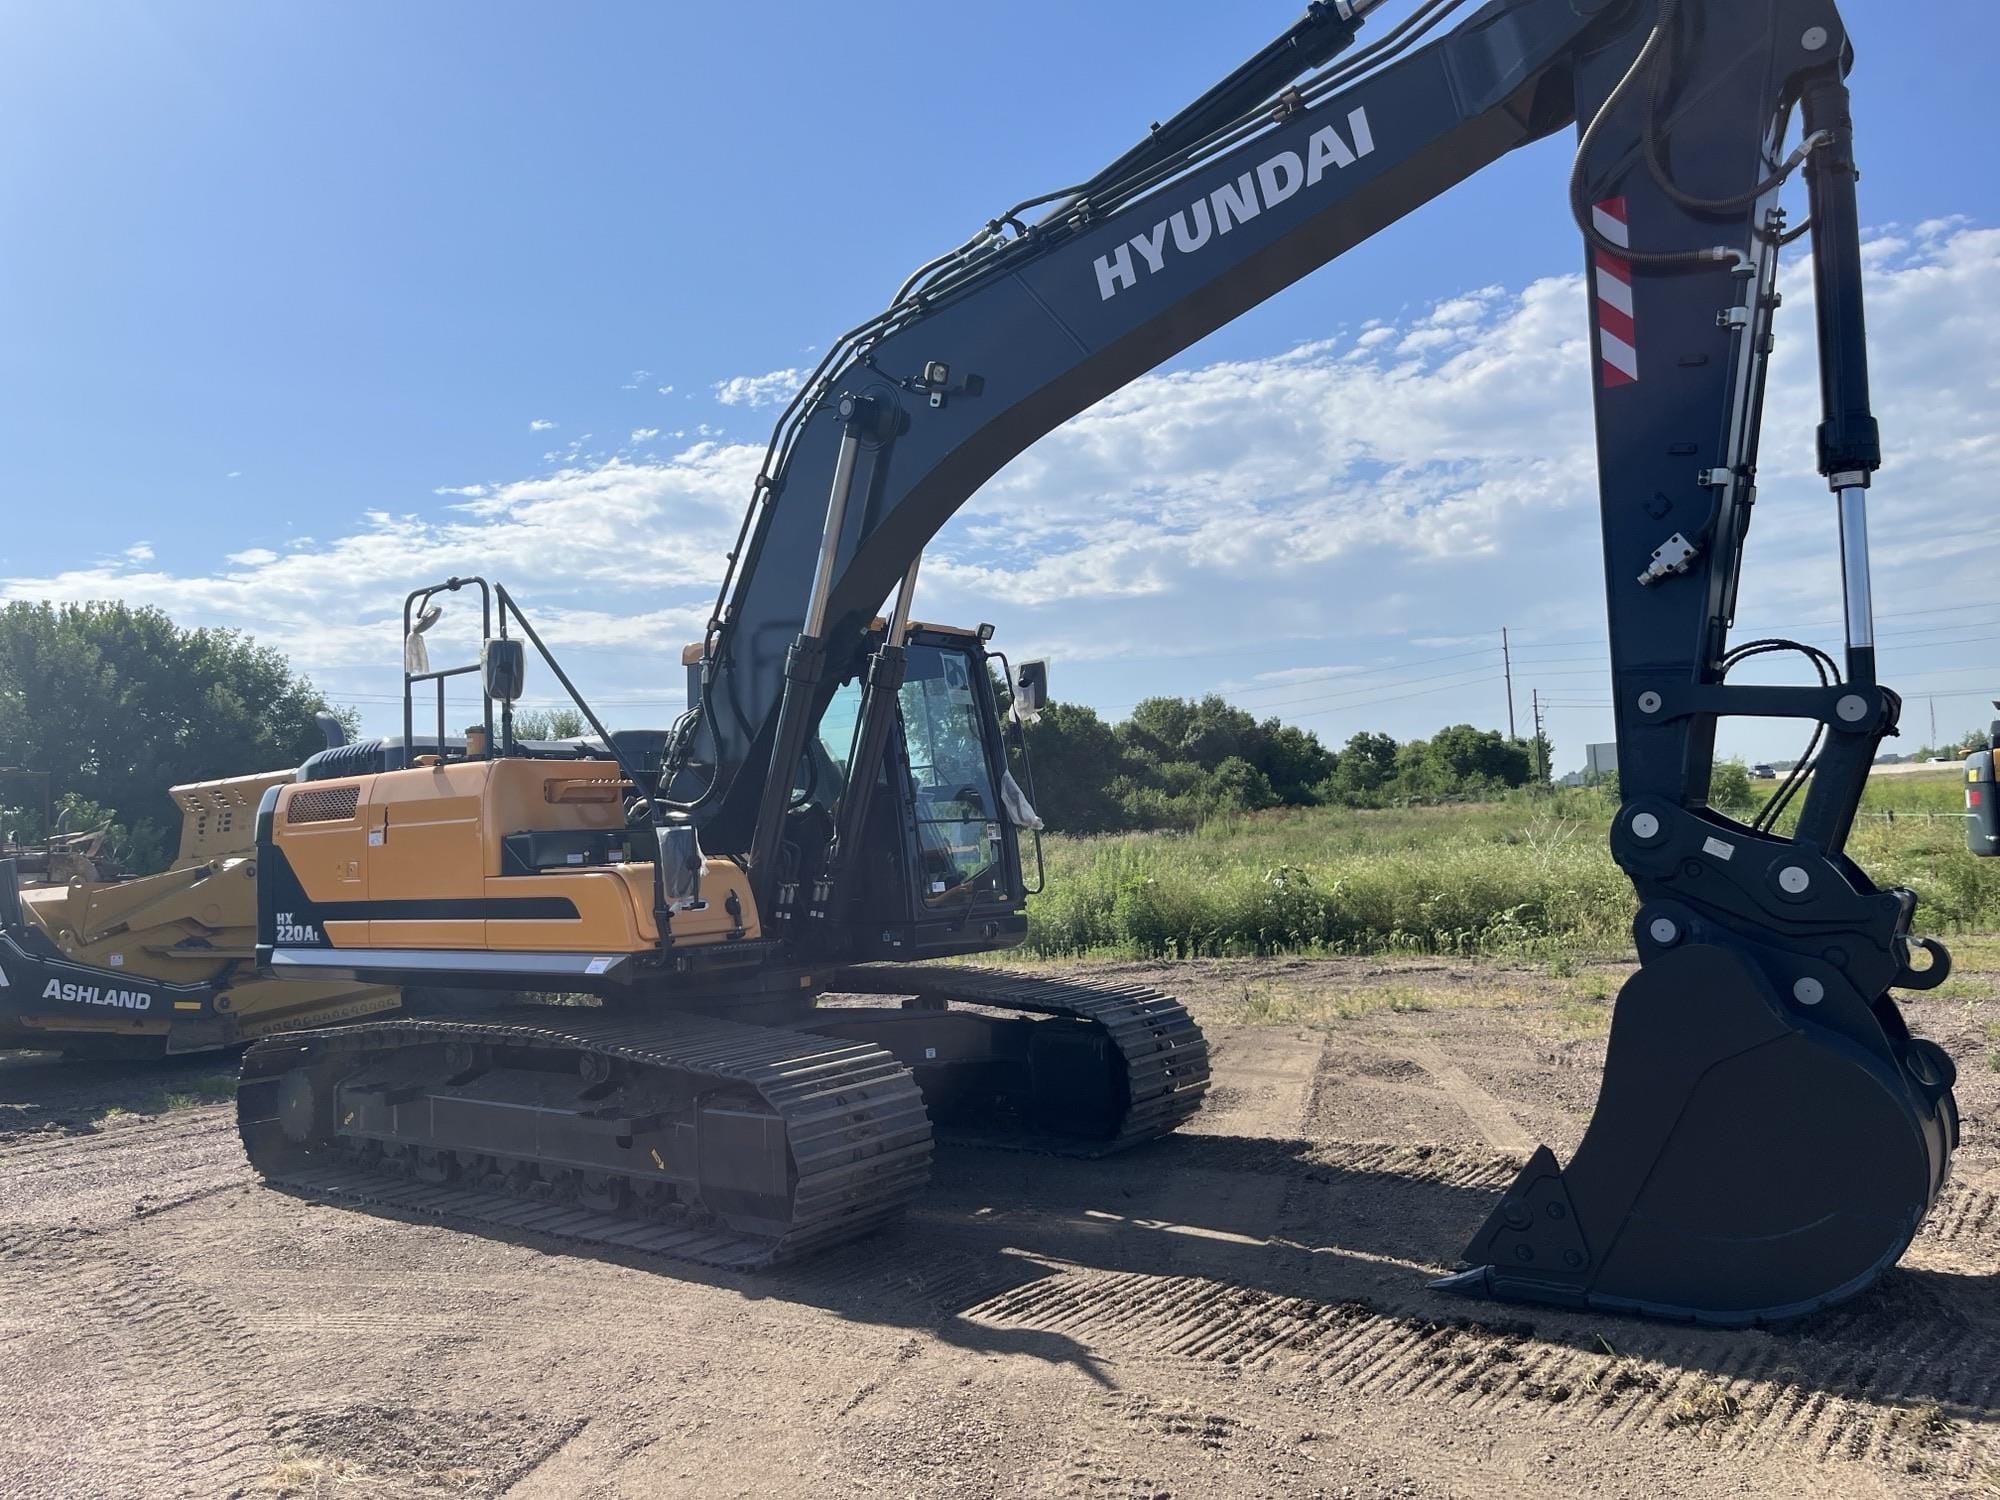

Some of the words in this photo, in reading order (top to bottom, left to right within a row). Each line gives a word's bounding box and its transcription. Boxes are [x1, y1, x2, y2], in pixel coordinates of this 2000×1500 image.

[1093, 106, 1375, 301] HYUNDAI
[276, 912, 294, 925] HX
[42, 978, 151, 1010] ASHLAND
